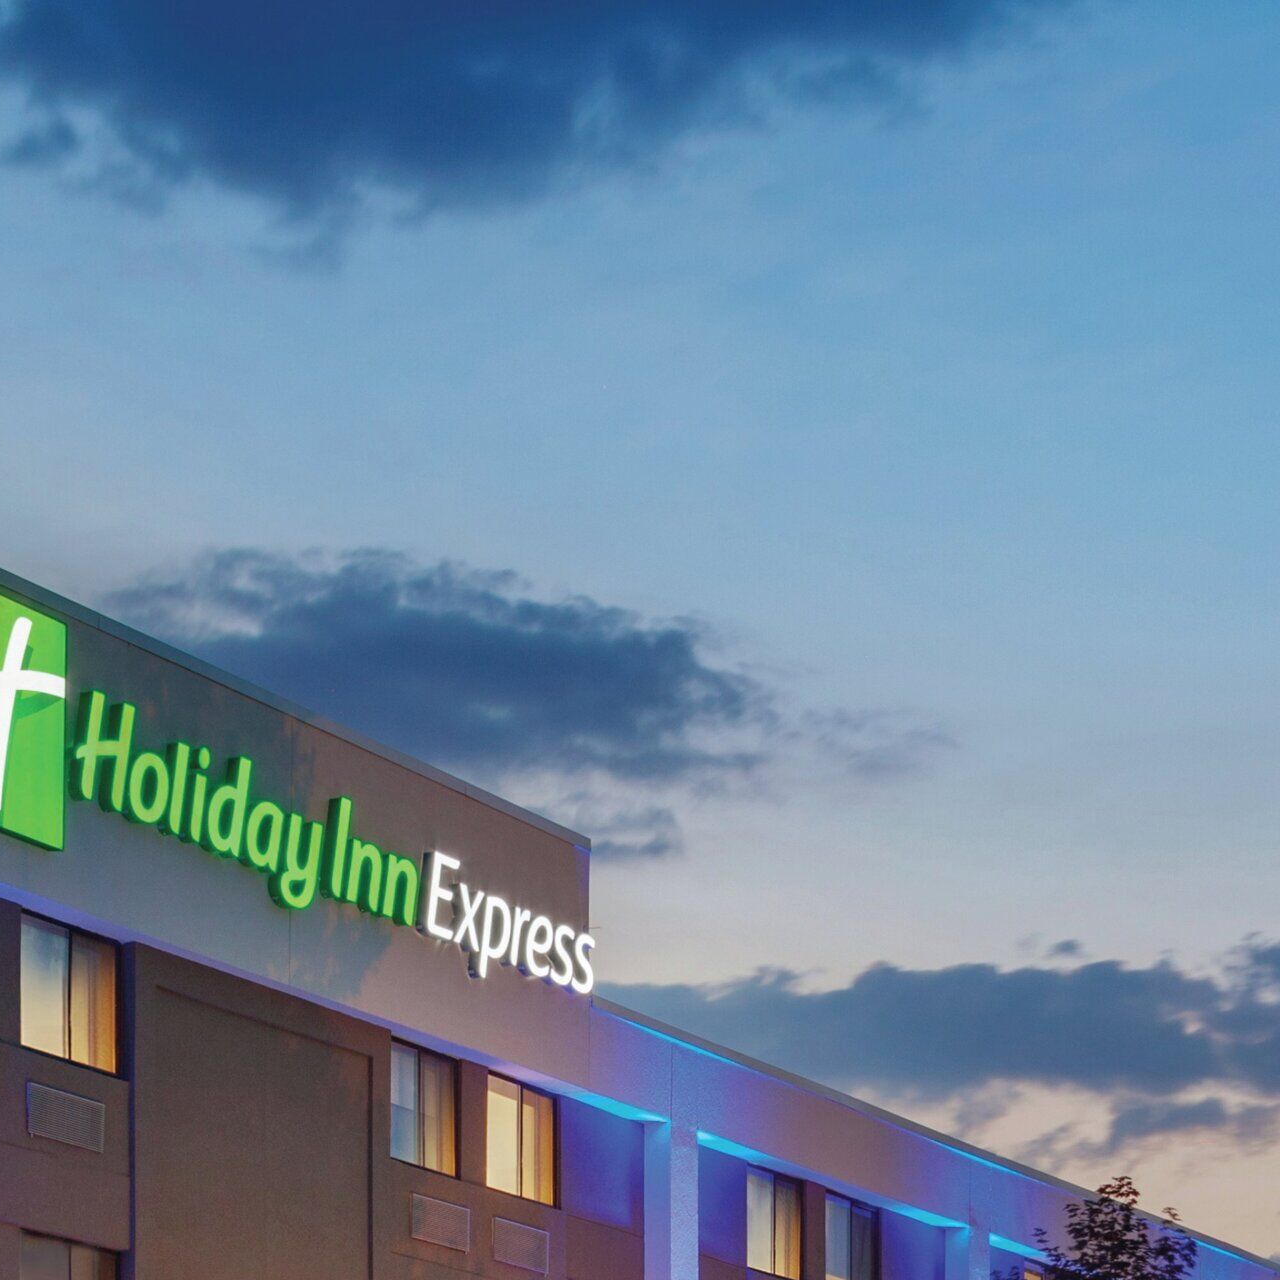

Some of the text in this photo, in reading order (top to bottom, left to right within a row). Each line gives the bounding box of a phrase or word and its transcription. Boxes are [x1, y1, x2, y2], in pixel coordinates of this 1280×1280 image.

[74, 690, 595, 994] Holiday Inn Express
